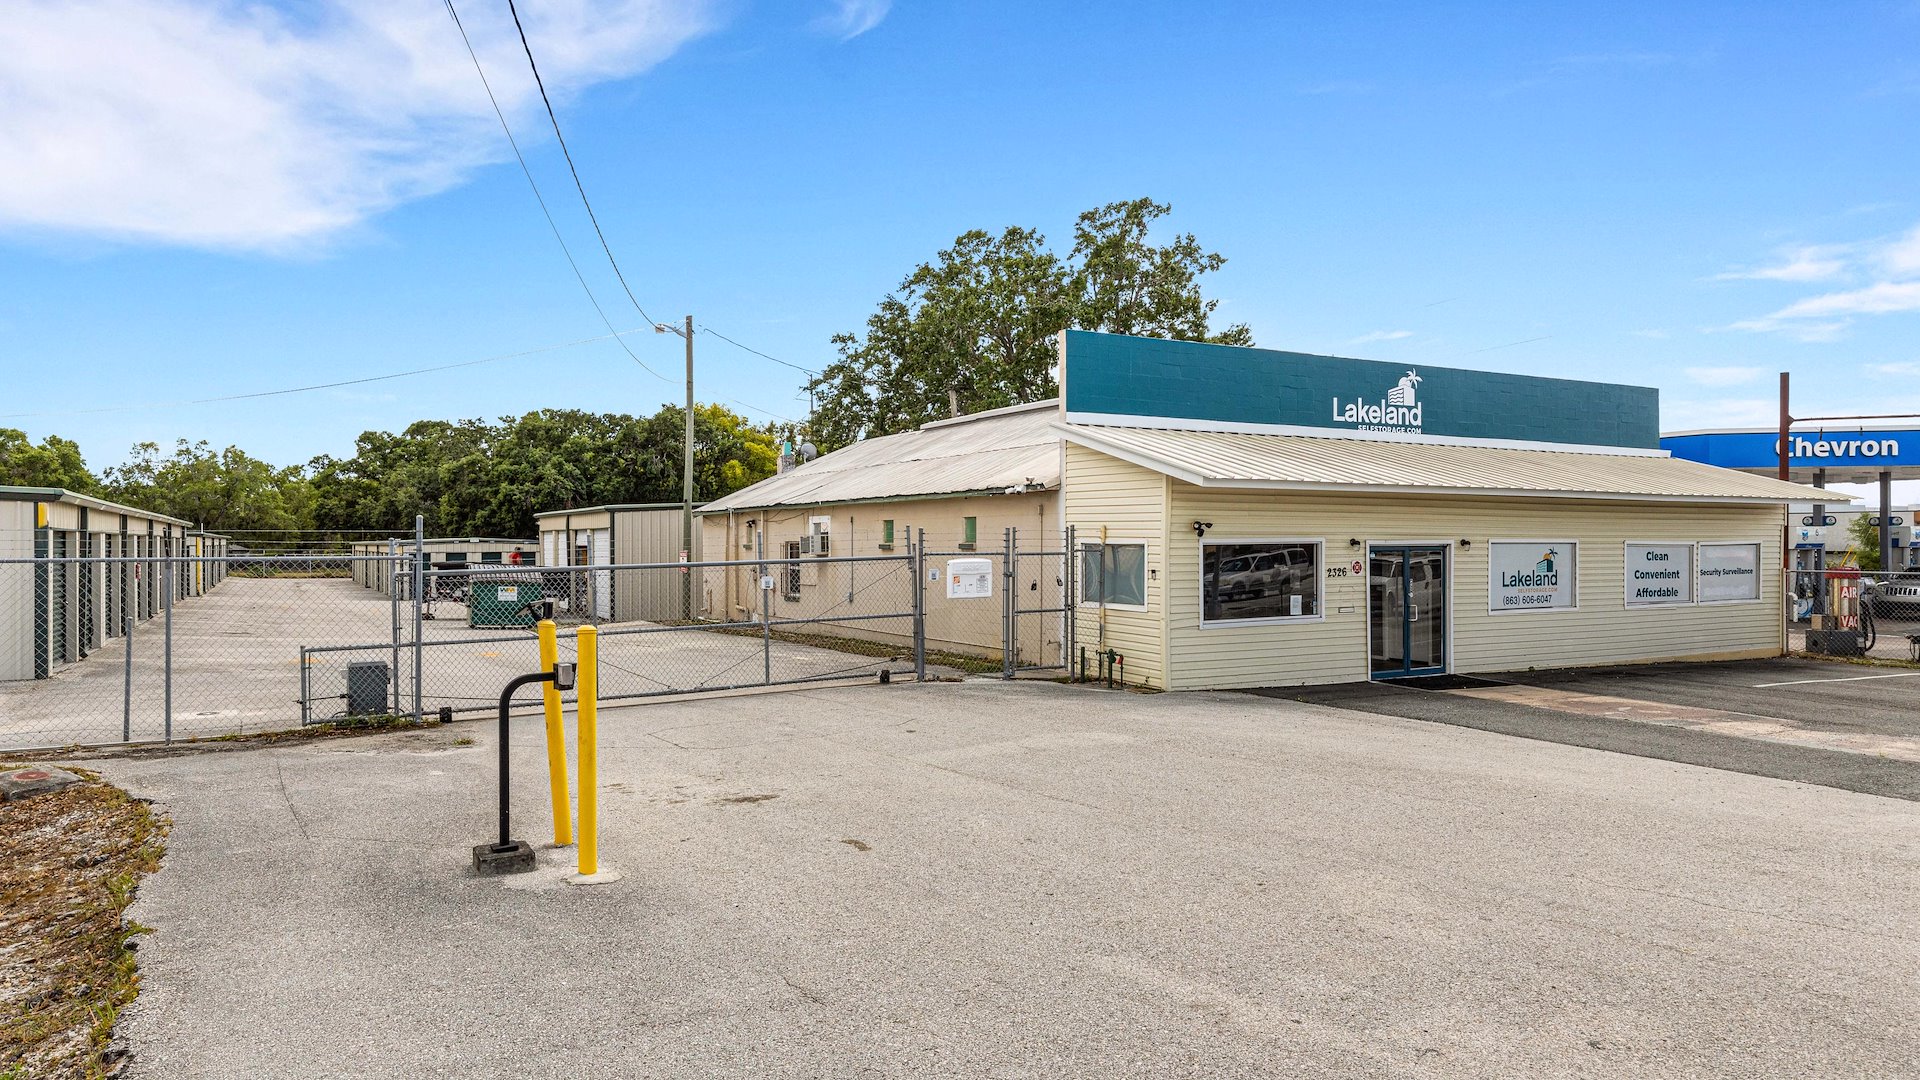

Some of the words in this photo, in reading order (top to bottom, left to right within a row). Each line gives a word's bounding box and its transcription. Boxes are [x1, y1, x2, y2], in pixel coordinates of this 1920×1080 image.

[1333, 397, 1422, 426] Lakeland
[1775, 436, 1899, 457] Chevron
[1646, 551, 1669, 561] Clean
[1327, 567, 1347, 578] 2326
[1634, 568, 1680, 580] Convenient
[1700, 567, 1721, 577] Security
[1722, 567, 1753, 576] Surveillance
[1502, 569, 1558, 588] Lakeland
[1636, 587, 1679, 598] Affordable
[1841, 586, 1857, 598] AIR
[1502, 595, 1521, 606] (863)
[1522, 594, 1552, 605] 606-6047
